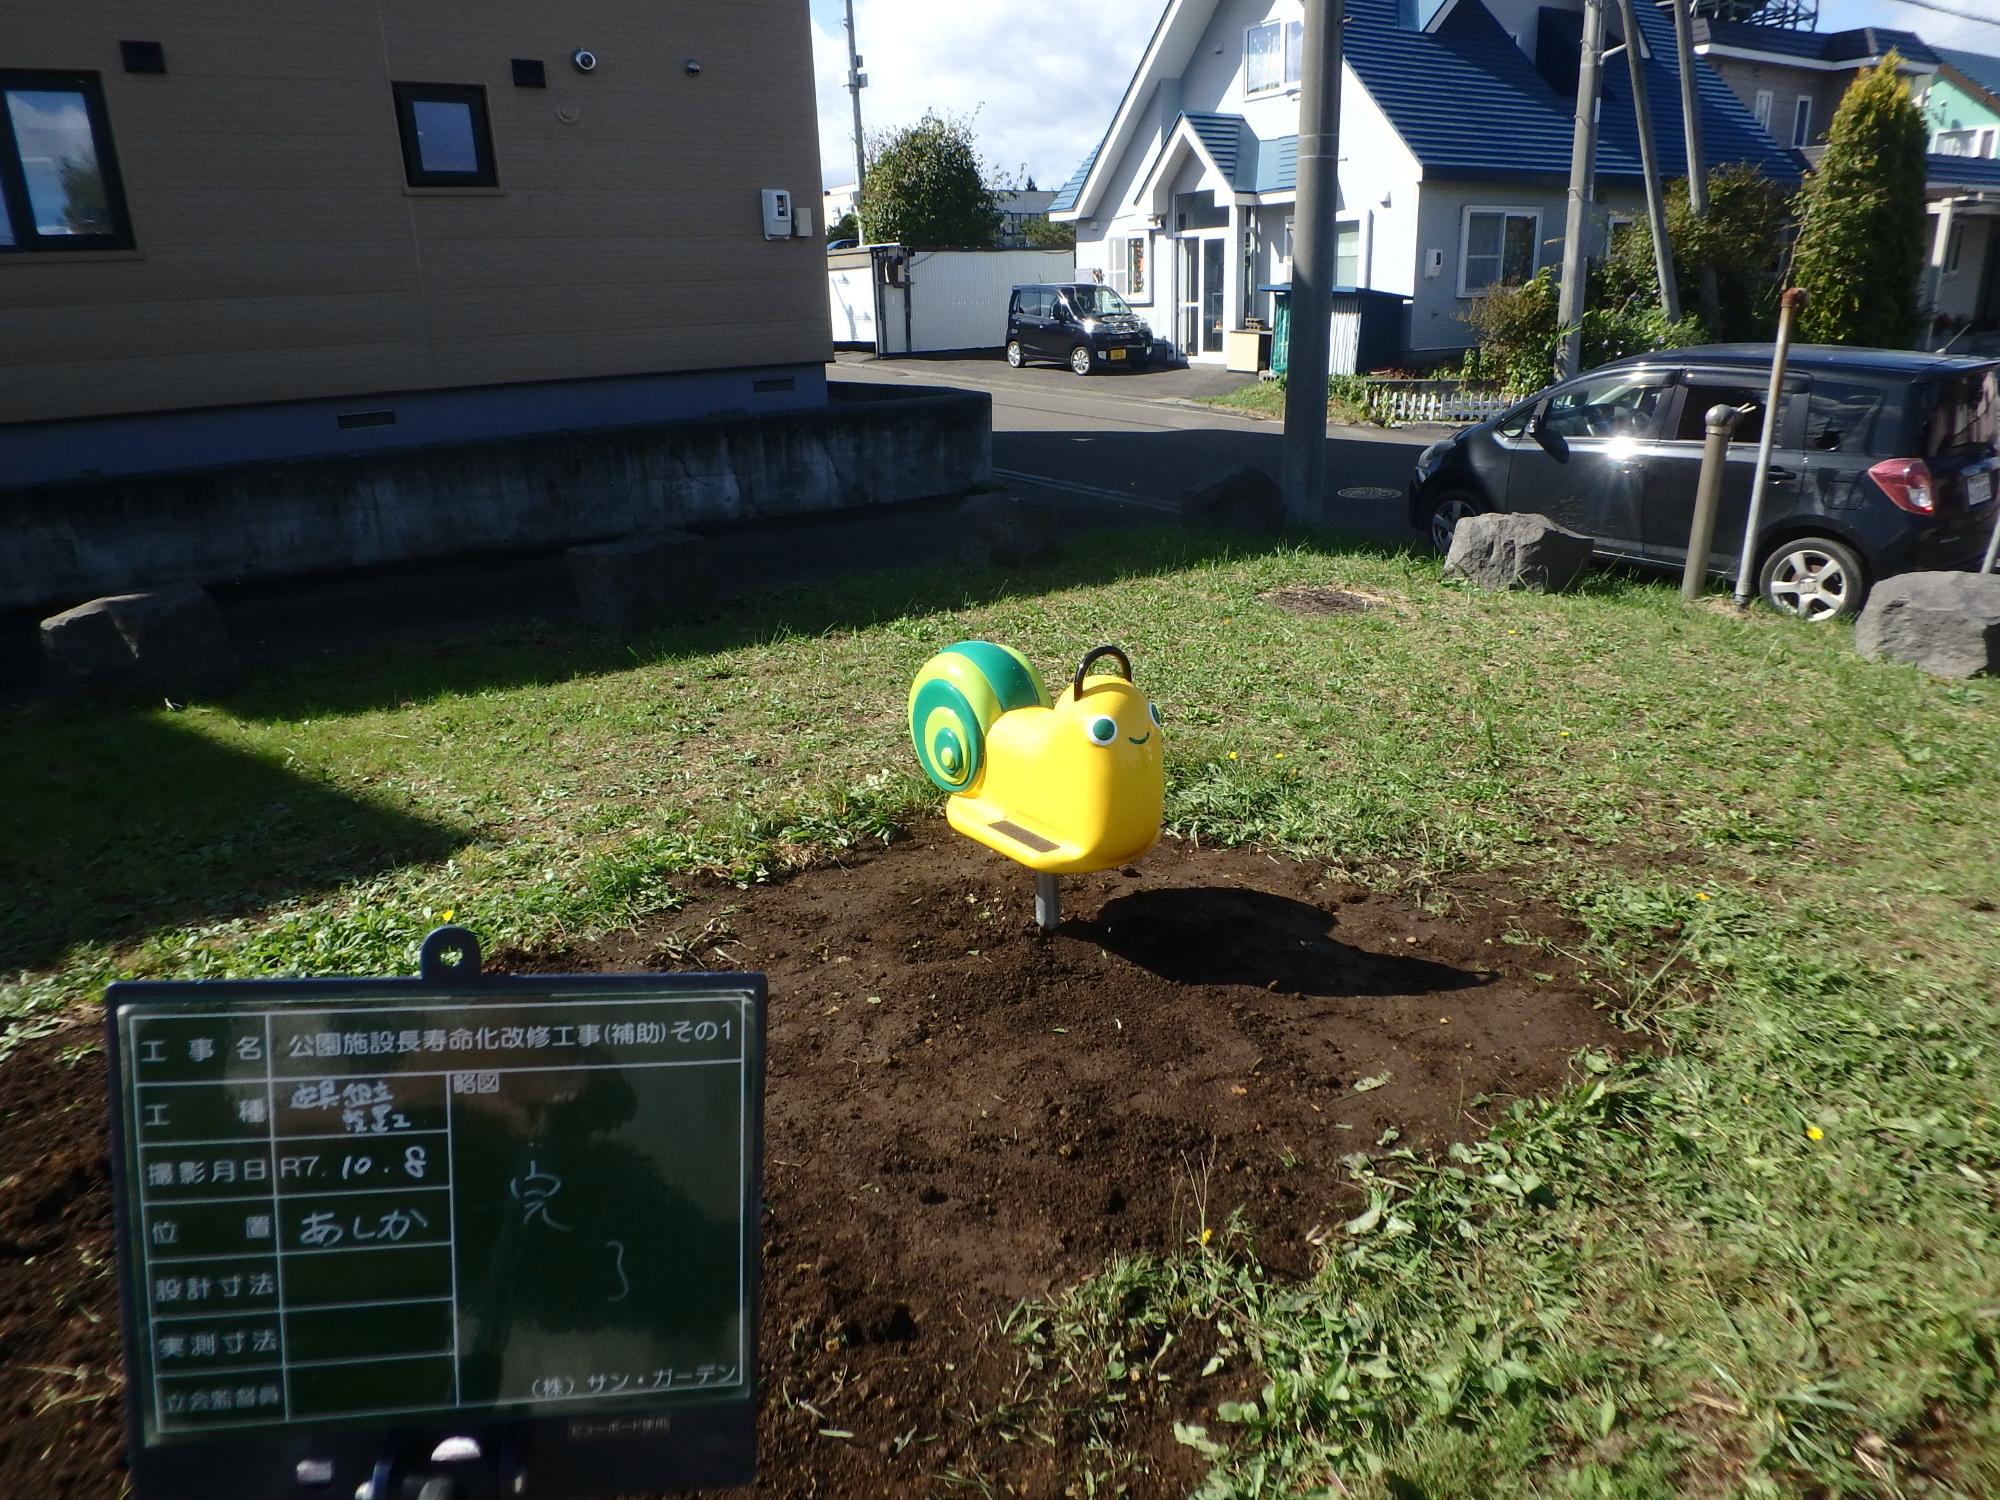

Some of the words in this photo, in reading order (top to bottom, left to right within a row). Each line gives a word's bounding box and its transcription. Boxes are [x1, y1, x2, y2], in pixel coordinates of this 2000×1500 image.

[453, 1072, 500, 1094] 略図
[149, 1159, 266, 1186] 撮影月日
[299, 1208, 429, 1247] あしか
[156, 1273, 275, 1302] 設計寸法
[159, 1329, 278, 1358] 実測寸法
